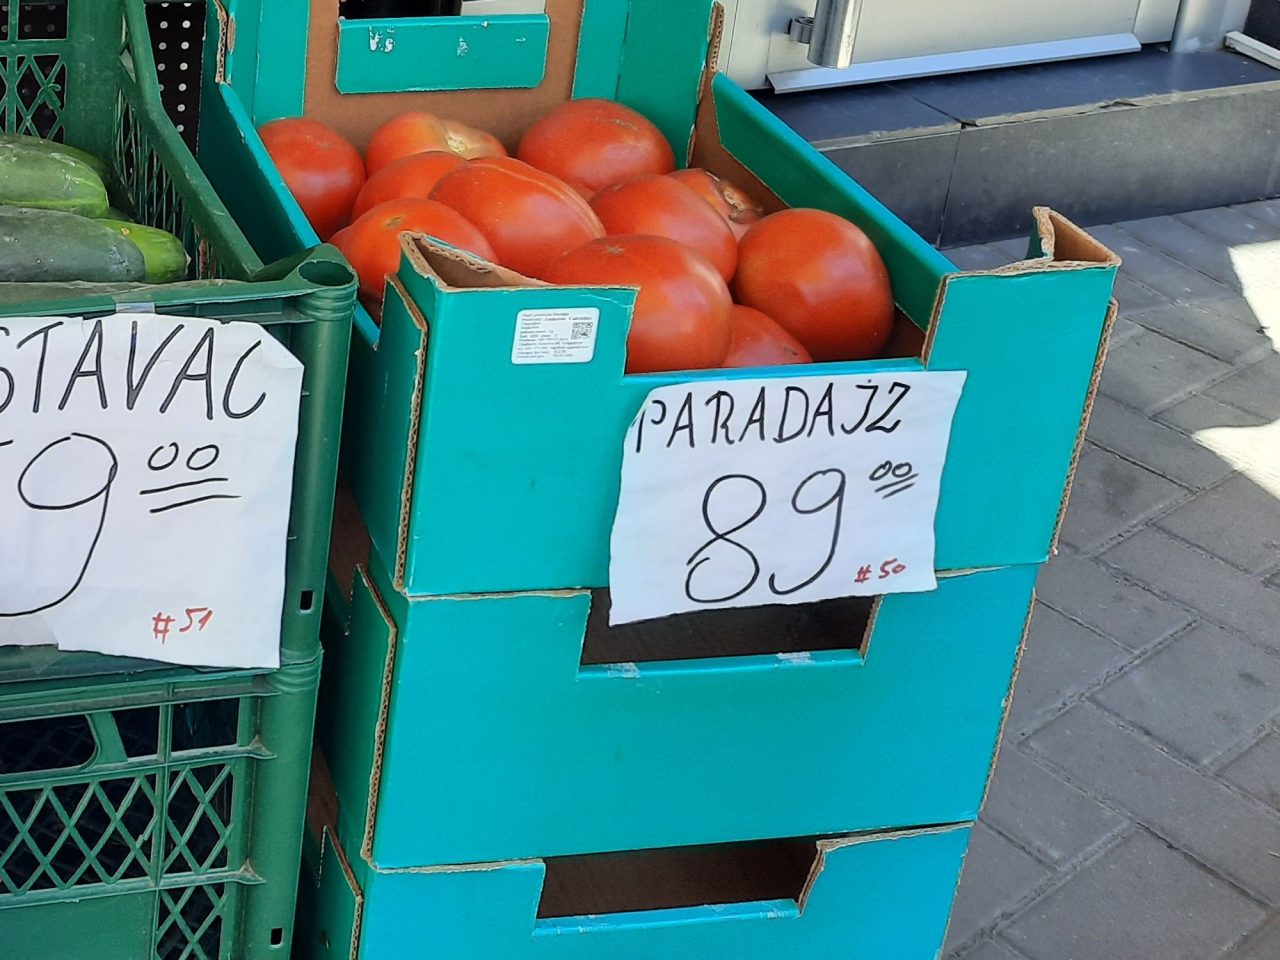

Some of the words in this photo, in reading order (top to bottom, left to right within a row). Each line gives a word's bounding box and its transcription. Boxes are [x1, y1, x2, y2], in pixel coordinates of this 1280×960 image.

[631, 380, 912, 453] PARADAJZ
[147, 441, 219, 471] 00
[685, 468, 846, 603] 89
[868, 460, 914, 481] 00
